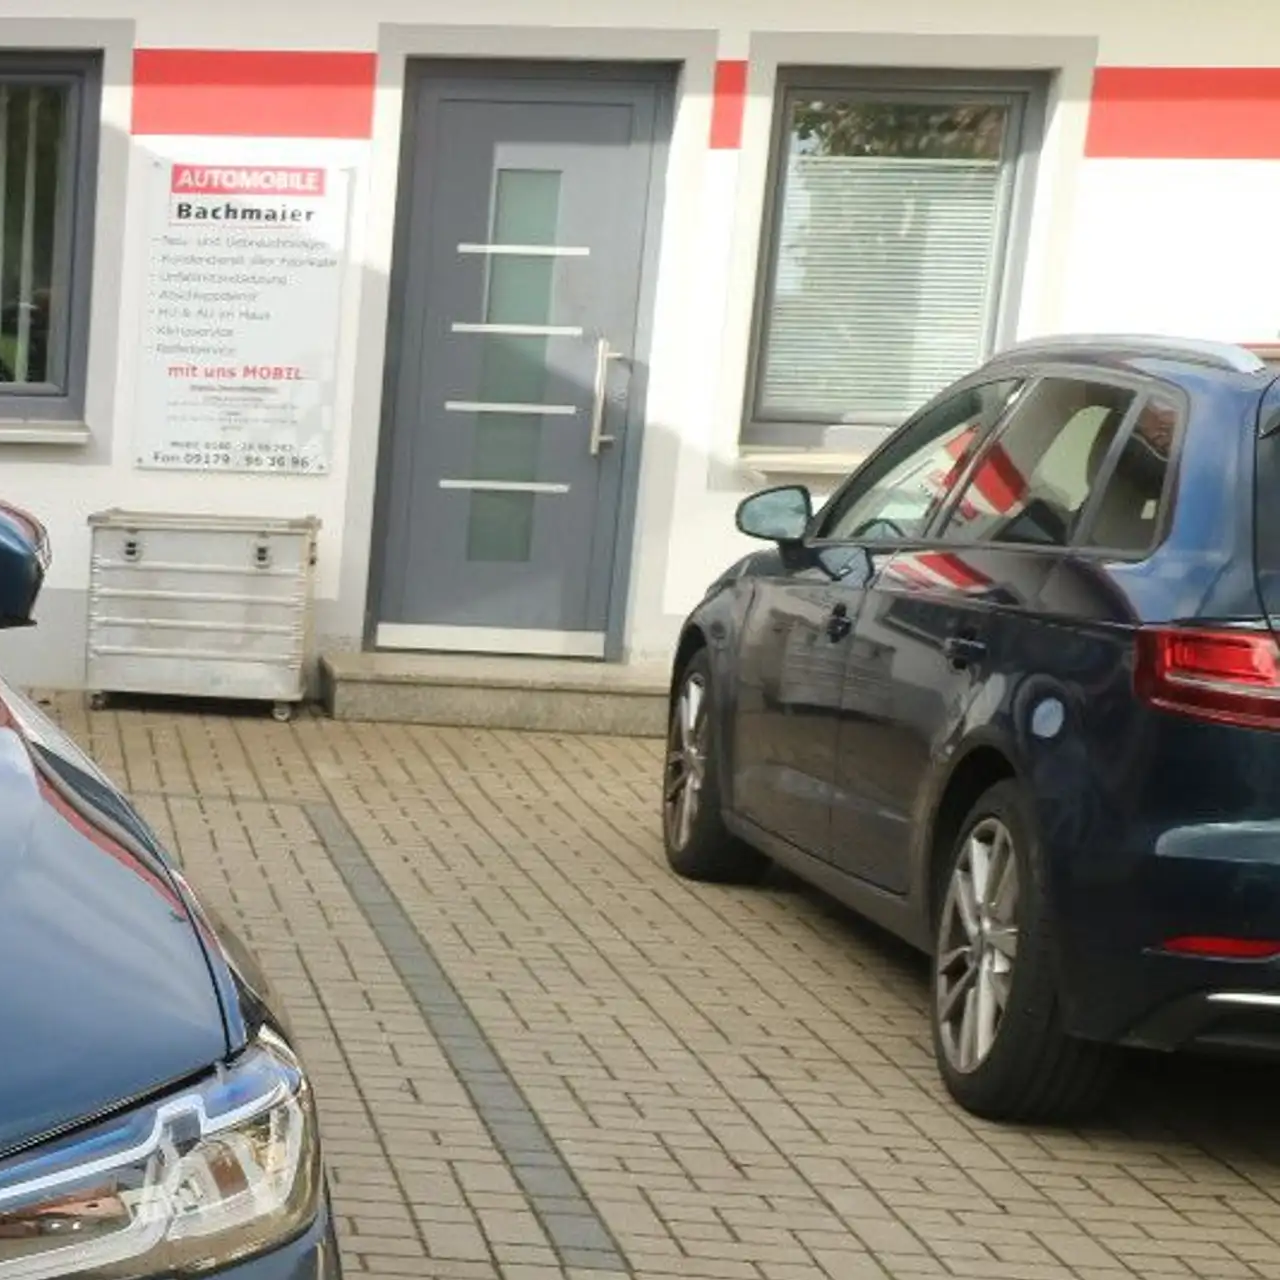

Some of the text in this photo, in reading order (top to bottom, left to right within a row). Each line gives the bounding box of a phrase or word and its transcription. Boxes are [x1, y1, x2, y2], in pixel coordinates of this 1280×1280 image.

[177, 169, 320, 192] AUTOMOBILE
[177, 203, 315, 222] Bachmaier
[168, 366, 302, 380] mit uns MOBIL
